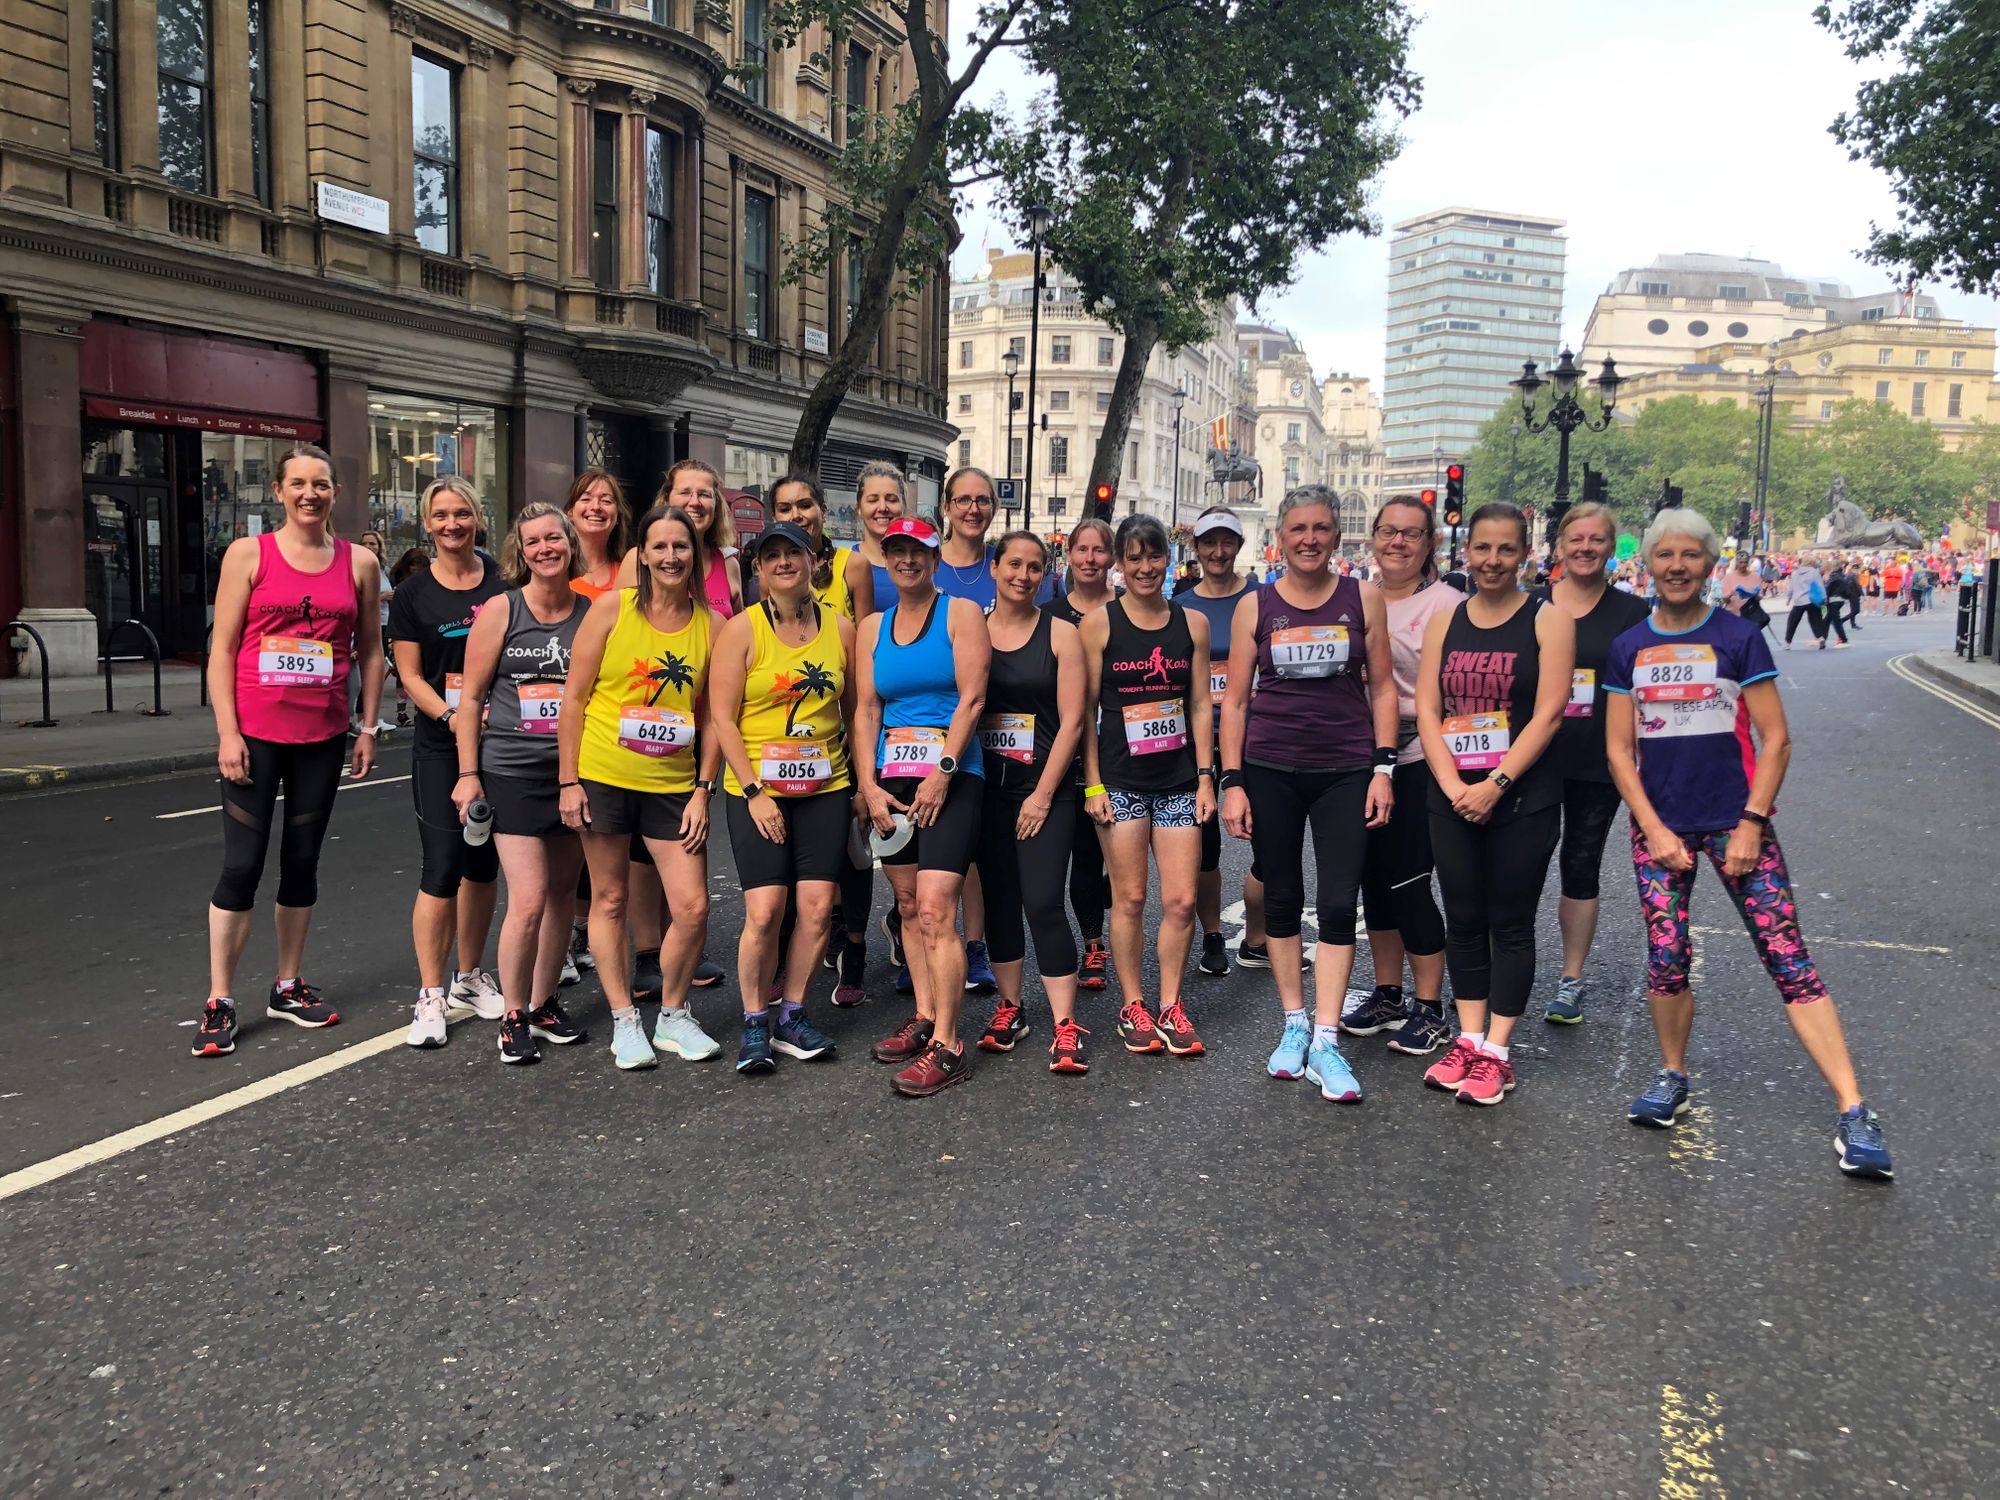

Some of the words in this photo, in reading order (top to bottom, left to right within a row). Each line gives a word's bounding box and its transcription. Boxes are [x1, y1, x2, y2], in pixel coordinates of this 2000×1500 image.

[323, 186, 385, 212] NORTHUMBERLAND
[323, 197, 350, 213] AVENUE
[351, 205, 366, 217] WC2
[119, 407, 156, 420] Breakfast
[177, 414, 199, 424] Lunch
[218, 418, 241, 429] Dinner
[260, 423, 297, 436] Pre-Theatre
[1001, 482, 1012, 497] P
[260, 604, 301, 615] COACH
[506, 647, 550, 657] COACH
[1287, 643, 1335, 662] 11729
[277, 655, 315, 672] 5895
[1112, 660, 1153, 671] COACH
[1302, 666, 1320, 674] ANNE
[1444, 650, 1518, 675] SWEAT
[274, 674, 296, 683] CLAIRE
[296, 675, 315, 684] SLEEP
[1650, 665, 1693, 683] 8828
[1211, 676, 1227, 690] 16
[1441, 671, 1516, 701] TODAY
[1657, 687, 1685, 697] ALISON
[539, 701, 562, 718] 65
[1143, 719, 1177, 738] 5868
[1674, 714, 1692, 727] UK
[638, 723, 677, 742] 6425
[984, 732, 1016, 748] 8006
[645, 744, 664, 754] MARY
[1154, 740, 1168, 748] KATE
[1455, 734, 1490, 753] 6718
[893, 745, 928, 761] 5789
[898, 765, 917, 773] KATHY
[1460, 757, 1487, 766] JENNIFER
[778, 762, 816, 778] 8056
[786, 783, 807, 791] PAULA
